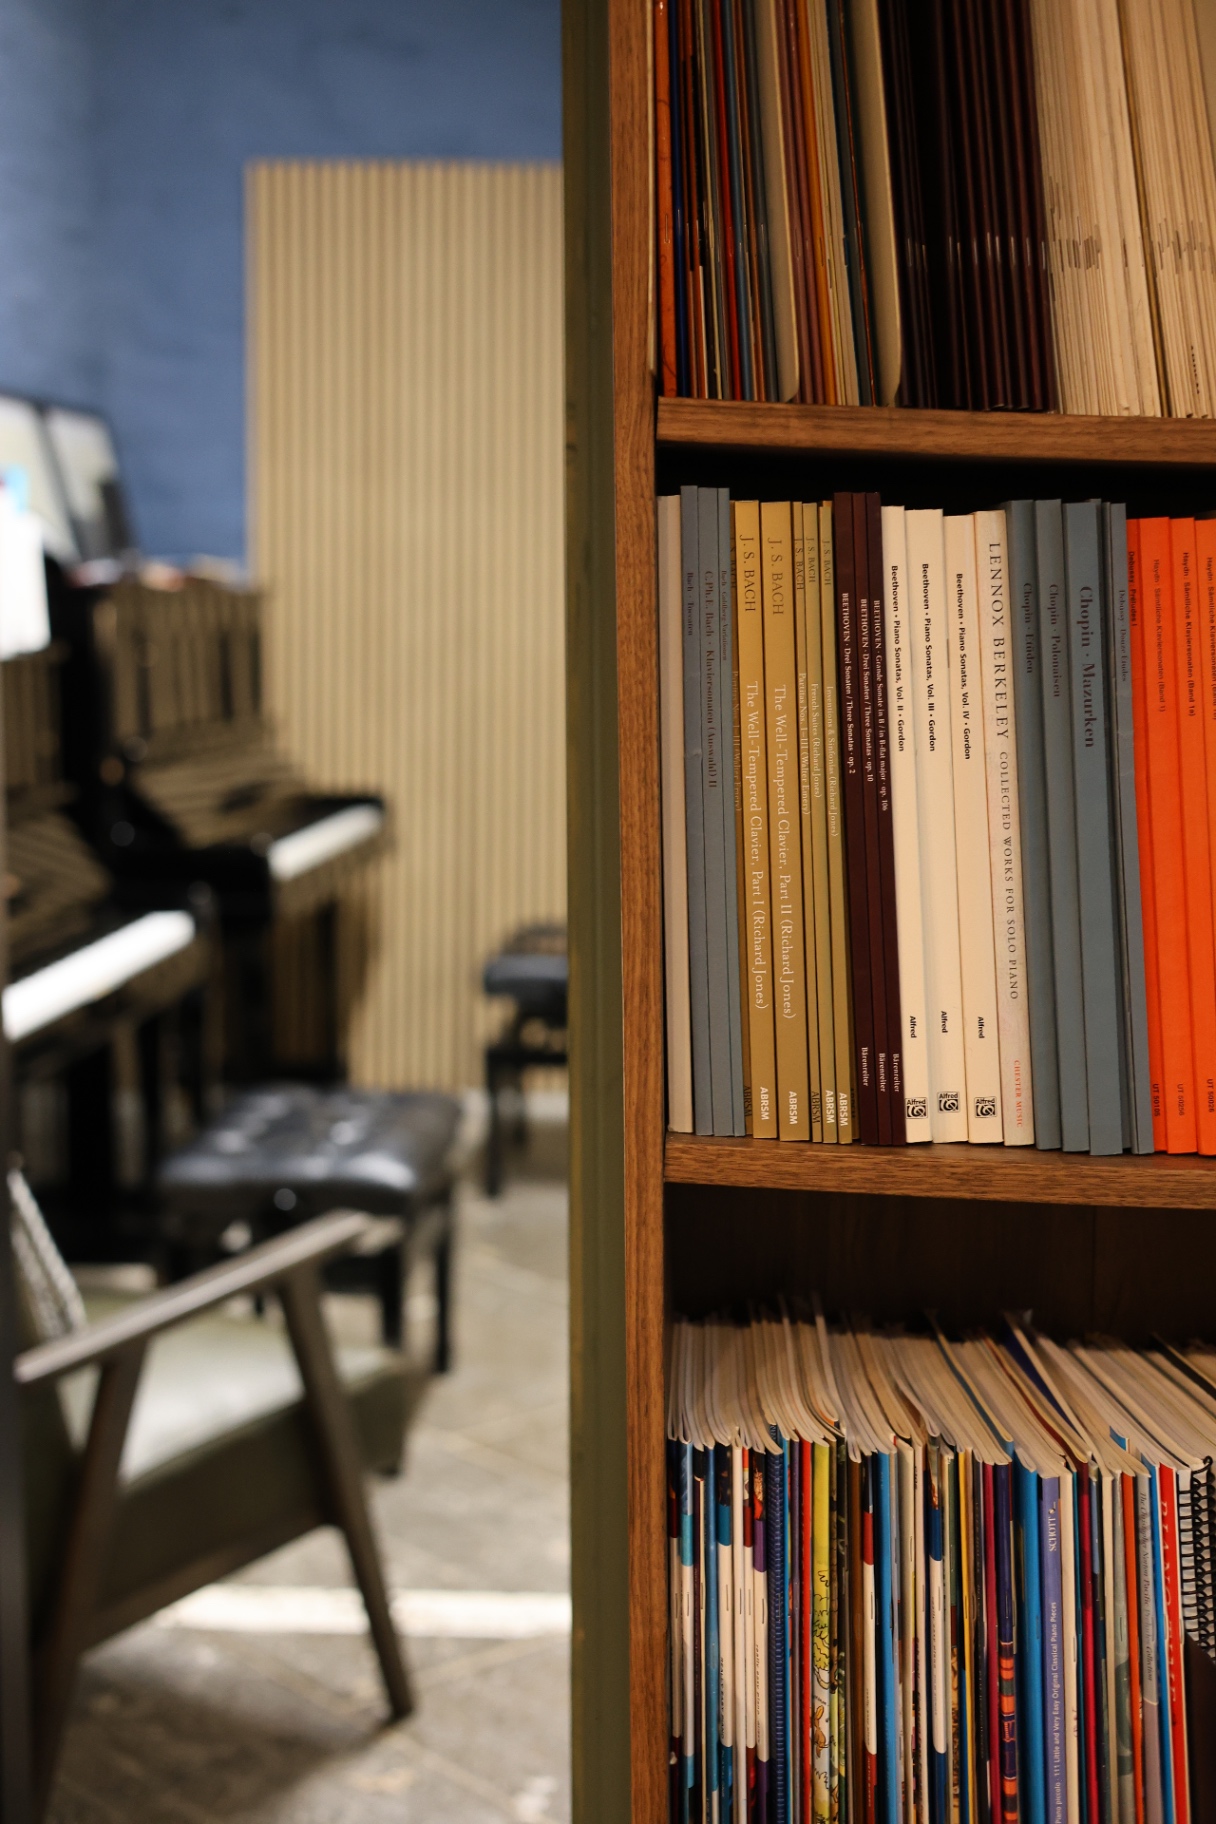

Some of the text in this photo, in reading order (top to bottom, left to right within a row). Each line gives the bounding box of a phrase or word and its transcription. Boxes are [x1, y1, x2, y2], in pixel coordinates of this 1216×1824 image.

[740, 535, 754, 546] J.
[808, 546, 815, 554] S.
[824, 550, 830, 558] S.
[744, 552, 754, 564] S.
[808, 557, 816, 583] BACH
[744, 570, 756, 612] BACH
[796, 561, 804, 590] BACH
[891, 566, 899, 612] Beethoven
[922, 564, 930, 610] Beethoven
[989, 543, 1004, 627] LENNOX
[842, 593, 850, 642] BEETHOVEN
[1022, 583, 1033, 623] Chopin
[1118, 590, 1126, 622] Debussy
[706, 612, 714, 636] Bach
[924, 618, 932, 642] Piano
[1047, 584, 1062, 697] Chopin Polonaisen
[844, 648, 852, 663] Drei
[925, 645, 933, 681] Sonatas,
[956, 574, 964, 619] Beethoven
[963, 711, 970, 719] IV
[1156, 626, 1164, 679] Klaviersonaten
[1186, 622, 1194, 678] Klaviersonaten
[873, 600, 882, 648] BEETHOVEN
[878, 730, 885, 738] in
[894, 648, 902, 684] Sonatas,
[1077, 587, 1097, 748] Chopin Mazurken
[706, 650, 716, 724] Klaviersonaten
[747, 681, 759, 707] The
[799, 673, 807, 703] Partitas
[811, 684, 819, 710] French
[896, 688, 904, 703] Vol.
[993, 638, 1008, 738] BERKELEY
[1158, 682, 1166, 703] (Band
[1187, 680, 1195, 702] (Band
[846, 700, 854, 721] Three
[746, 712, 762, 811] Well-Tempered
[801, 752, 809, 782] (Walter
[812, 738, 820, 771] (Richard
[708, 780, 716, 788] II
[802, 785, 810, 815] Emery)
[812, 773, 821, 798] Jones)
[828, 776, 837, 810] (Richard
[1000, 752, 1011, 830] COLLECTED
[750, 816, 762, 865] Clavier,
[768, 538, 797, 1124] J. S. BACH The Well-Tempered Clavier, Part II (Richard Jones) ABRSM
[829, 812, 838, 836] Jones)
[860, 599, 868, 648] BEETHOVEN
[864, 761, 872, 772] op.
[879, 1052, 887, 1092] Bärenreiter
[1003, 836, 1013, 882] WORKS
[752, 871, 763, 896] Part
[1006, 889, 1014, 913] FOR
[752, 910, 766, 965] (Richard
[1007, 920, 1016, 953] SOLO
[752, 968, 769, 1009] Jones)
[1009, 960, 1018, 1000] PIANO
[909, 1016, 917, 1038] Alfred
[1152, 1084, 1159, 1093] UT
[1177, 1084, 1183, 1093] UT
[1207, 1078, 1213, 1088] UT
[760, 1087, 769, 1120] ABRSM
[811, 1091, 821, 1124] ABRSM
[825, 1090, 834, 1123] ABRSM
[839, 1093, 849, 1126] ABRSM
[1048, 1517, 1057, 1552] SCHOTT
[1051, 1673, 1060, 1698] Original
[1052, 1700, 1060, 1714] Easy
[1054, 1782, 1062, 1804] piccolo
